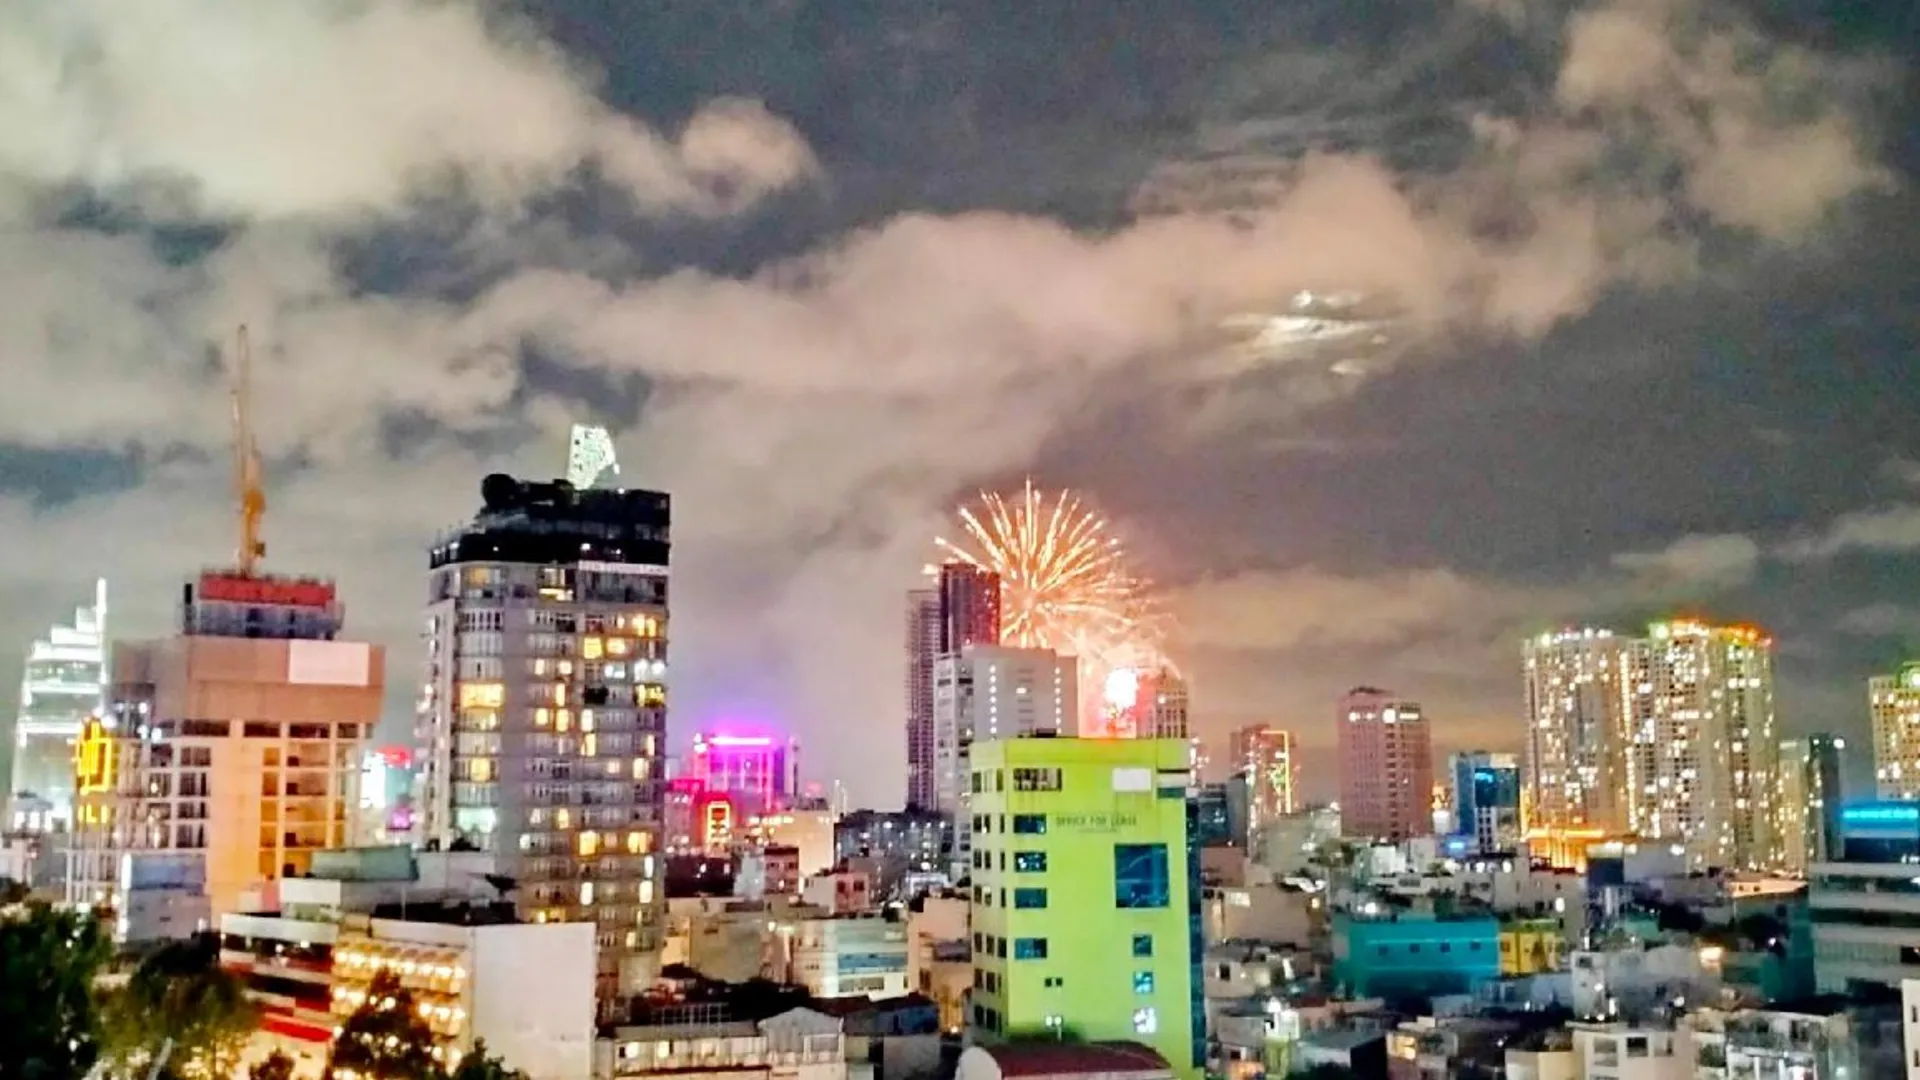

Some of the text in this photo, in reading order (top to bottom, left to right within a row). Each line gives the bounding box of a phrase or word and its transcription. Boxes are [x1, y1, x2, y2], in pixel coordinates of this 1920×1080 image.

[1056, 815, 1137, 826] OFFICE FOR LEASE
